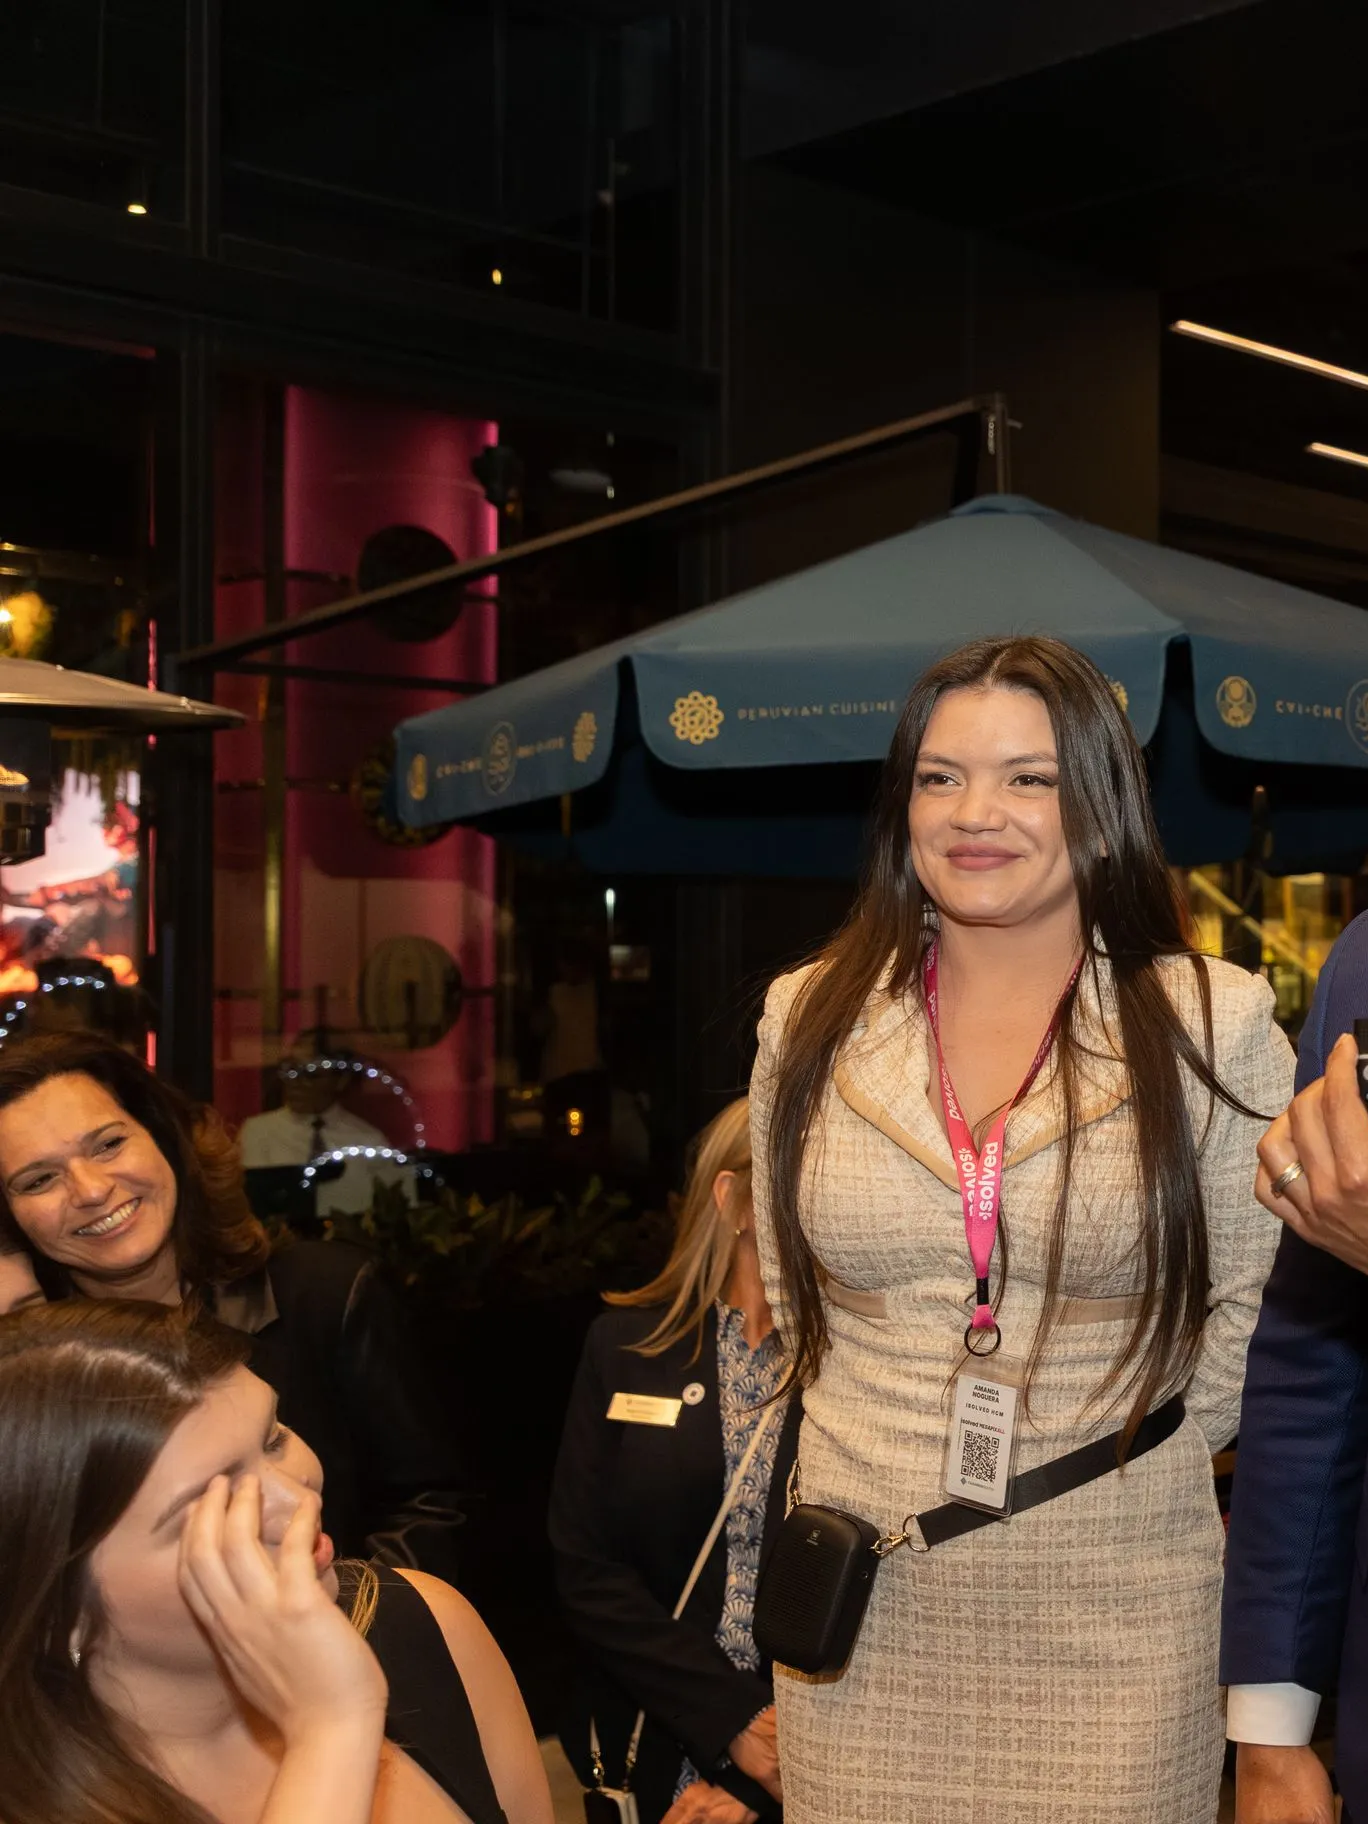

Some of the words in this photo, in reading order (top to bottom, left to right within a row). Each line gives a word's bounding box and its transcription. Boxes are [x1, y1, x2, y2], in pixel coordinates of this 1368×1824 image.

[737, 704, 823, 721] PERUVIAN
[958, 1147, 976, 1217] isolve
[978, 1141, 998, 1221] isolved
[972, 1391, 1000, 1403] NOGUERA
[974, 1384, 1000, 1397] AMANDA
[965, 1402, 990, 1414] ISOLVED
